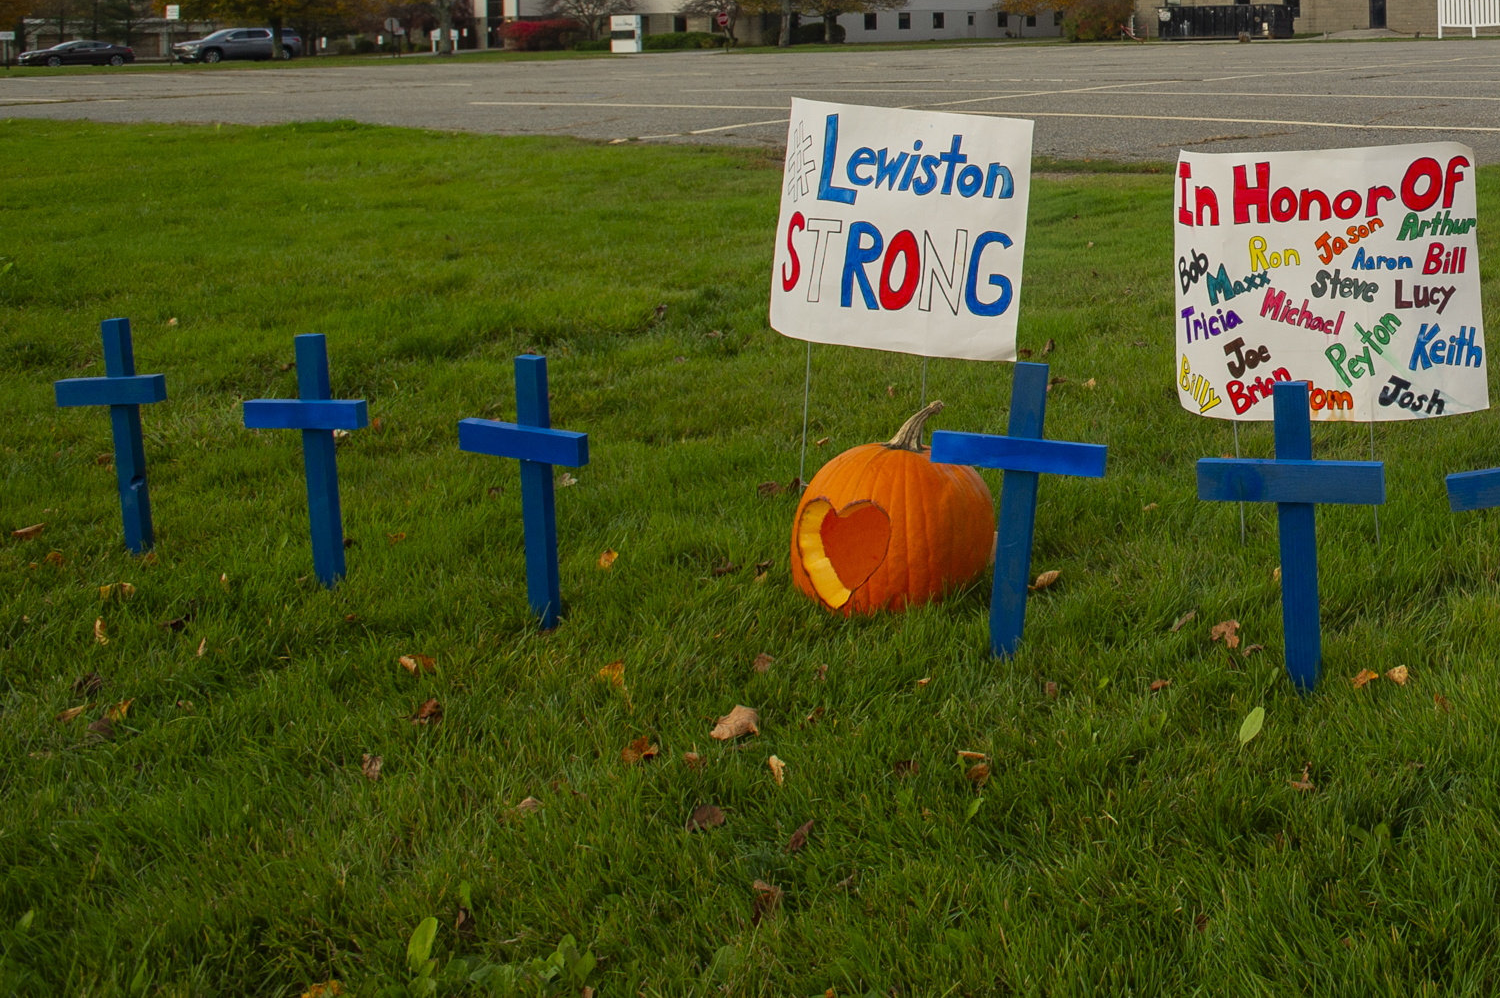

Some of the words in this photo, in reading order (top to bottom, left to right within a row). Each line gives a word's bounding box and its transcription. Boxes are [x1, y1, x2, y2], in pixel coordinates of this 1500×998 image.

[787, 113, 1015, 205] #Lewiston
[1178, 161, 1220, 227] In
[1232, 161, 1397, 225] Honor
[1400, 155, 1471, 212] Of
[1314, 217, 1384, 266] Jason
[1396, 210, 1477, 241] Arthur
[781, 211, 1014, 317] STRONG
[1178, 248, 1209, 295] Bob
[1248, 235, 1301, 273] Ron
[1351, 246, 1414, 271] Aaron
[1421, 242, 1467, 275] Bill
[1206, 263, 1271, 306] Maxx
[1310, 268, 1379, 303] Steve
[1394, 279, 1457, 315] Lucy
[1181, 305, 1244, 344] Tricia
[1259, 286, 1346, 336] Michael
[1223, 336, 1272, 379] Joe
[1324, 312, 1403, 388] Peyton
[1408, 322, 1483, 371] Keith
[1178, 353, 1222, 414] Billy
[1225, 366, 1292, 415] Brian
[1378, 374, 1446, 415] Josh
